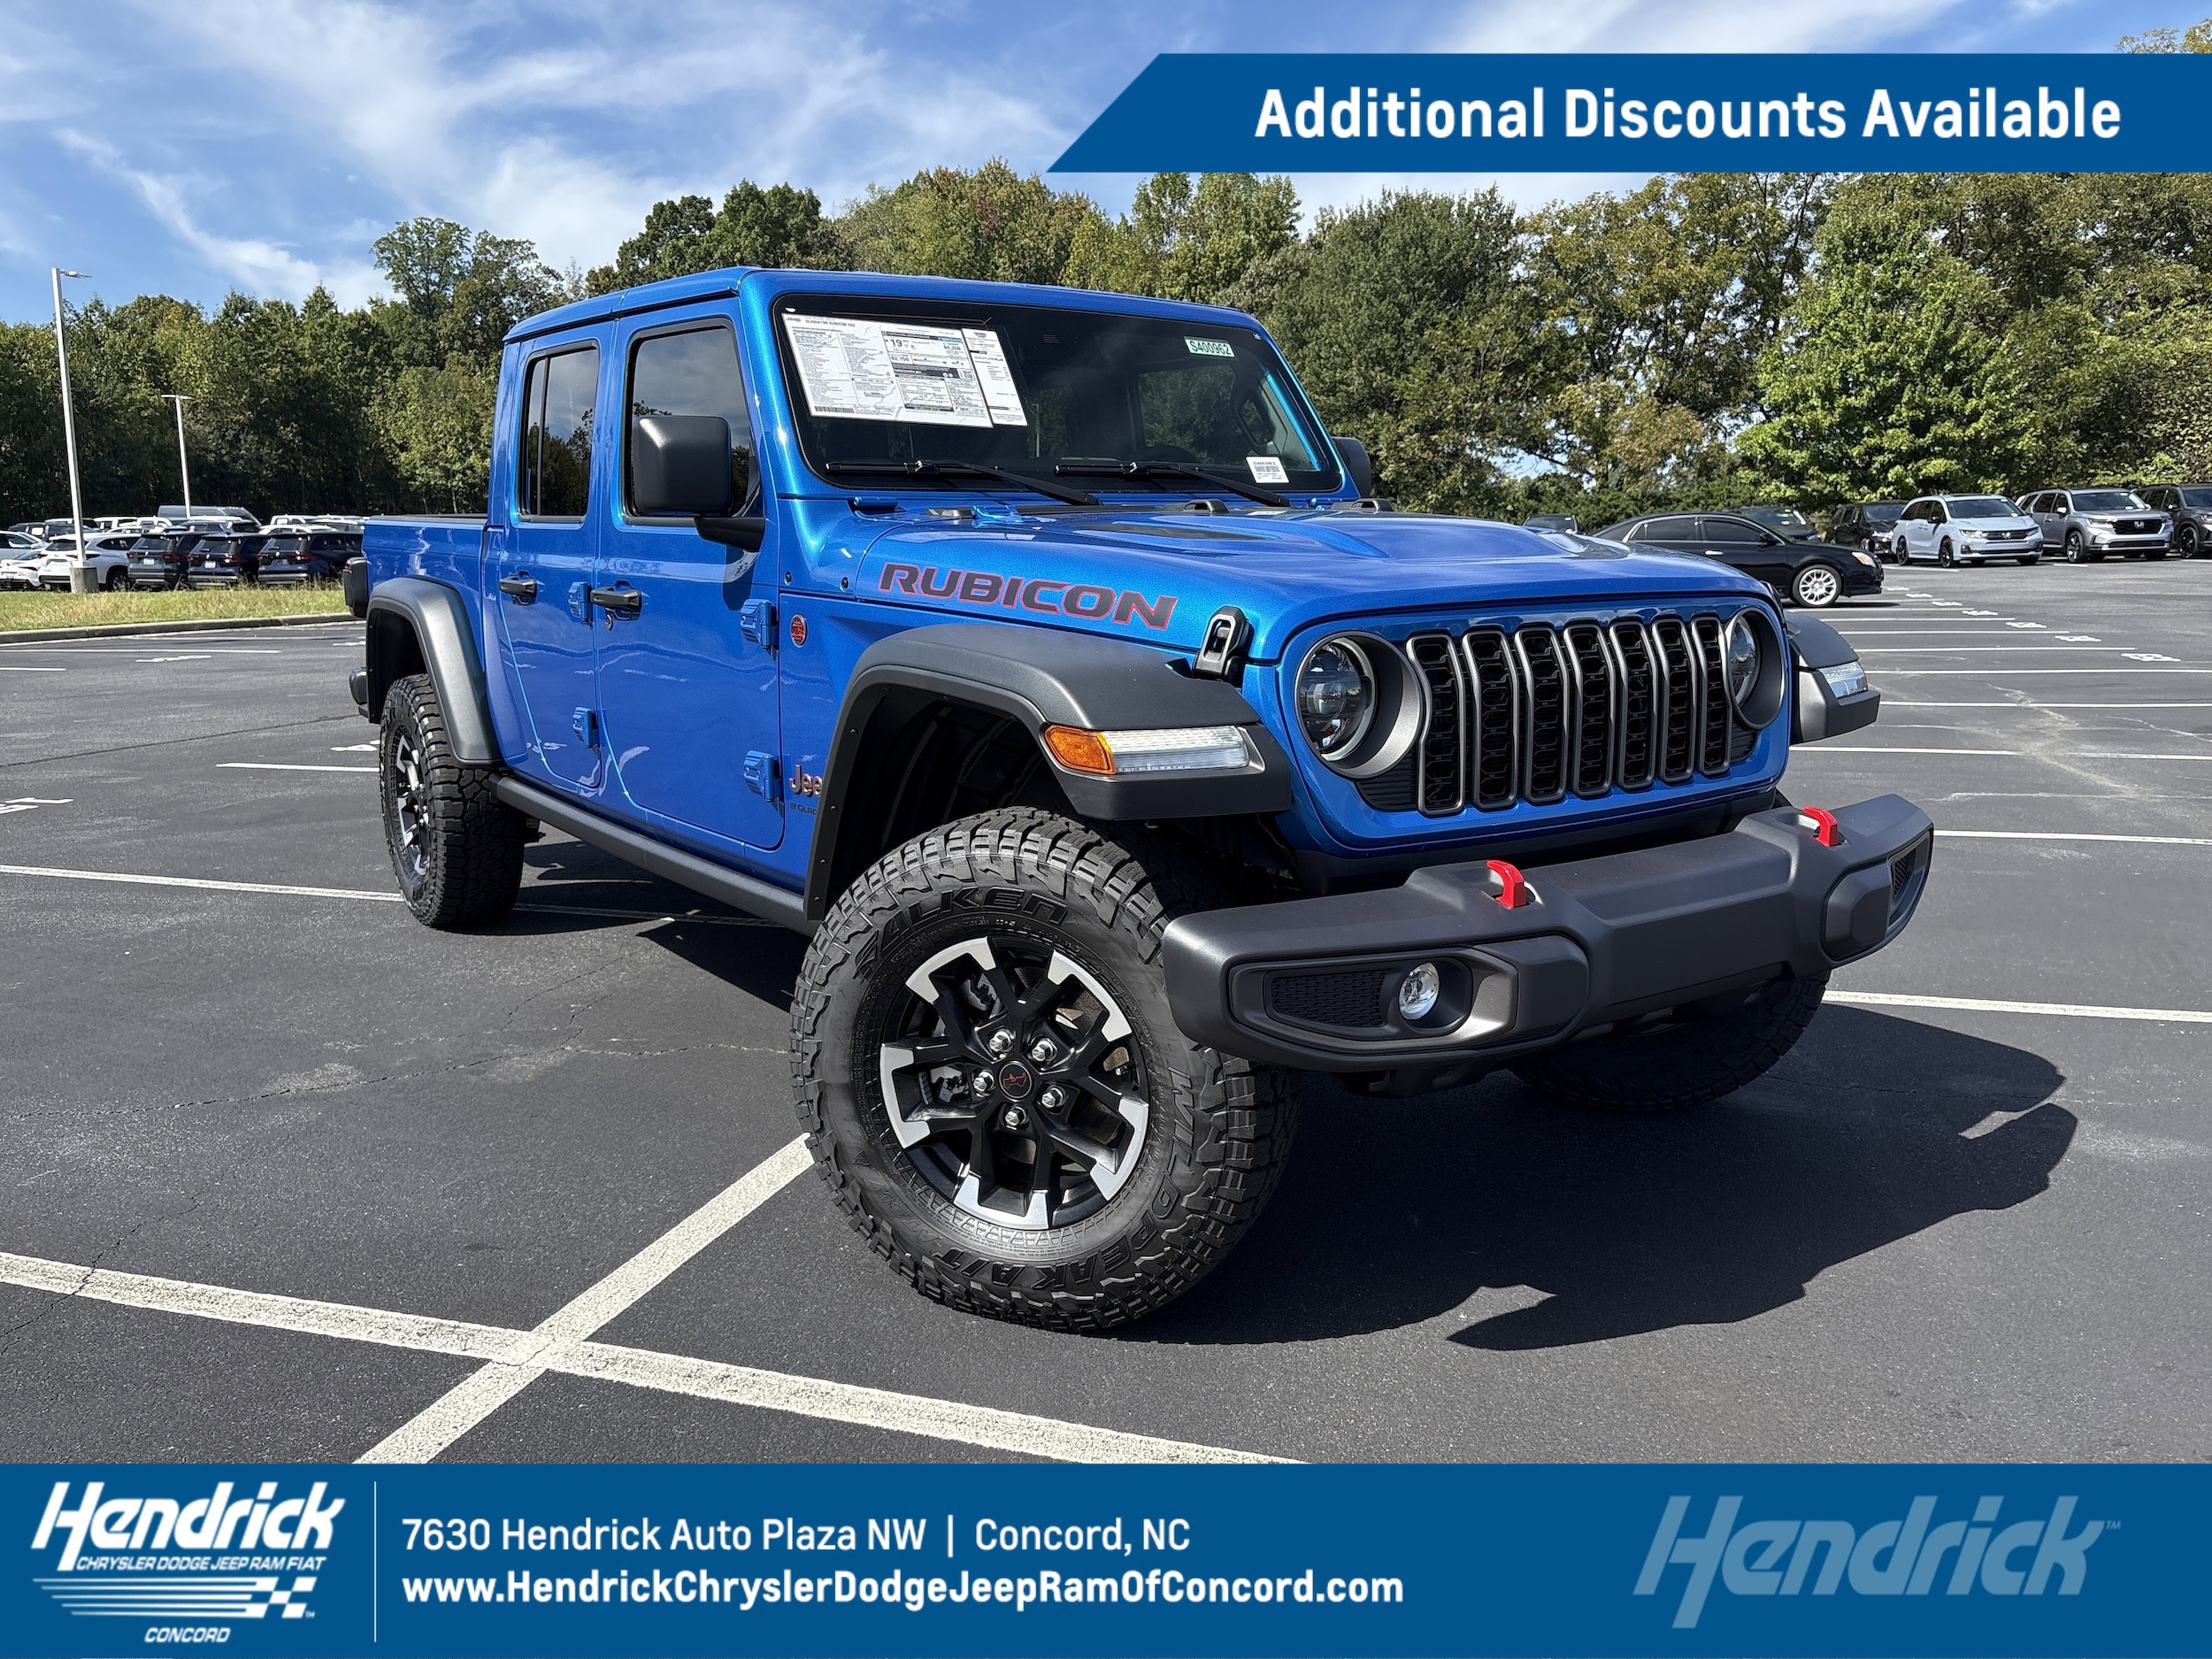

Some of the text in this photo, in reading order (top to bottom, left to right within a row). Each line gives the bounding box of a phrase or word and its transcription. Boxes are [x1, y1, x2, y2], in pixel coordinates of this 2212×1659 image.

[1189, 340, 1232, 355] S400962
[879, 562, 1178, 630] RUBICON
[789, 764, 823, 796] Jee
